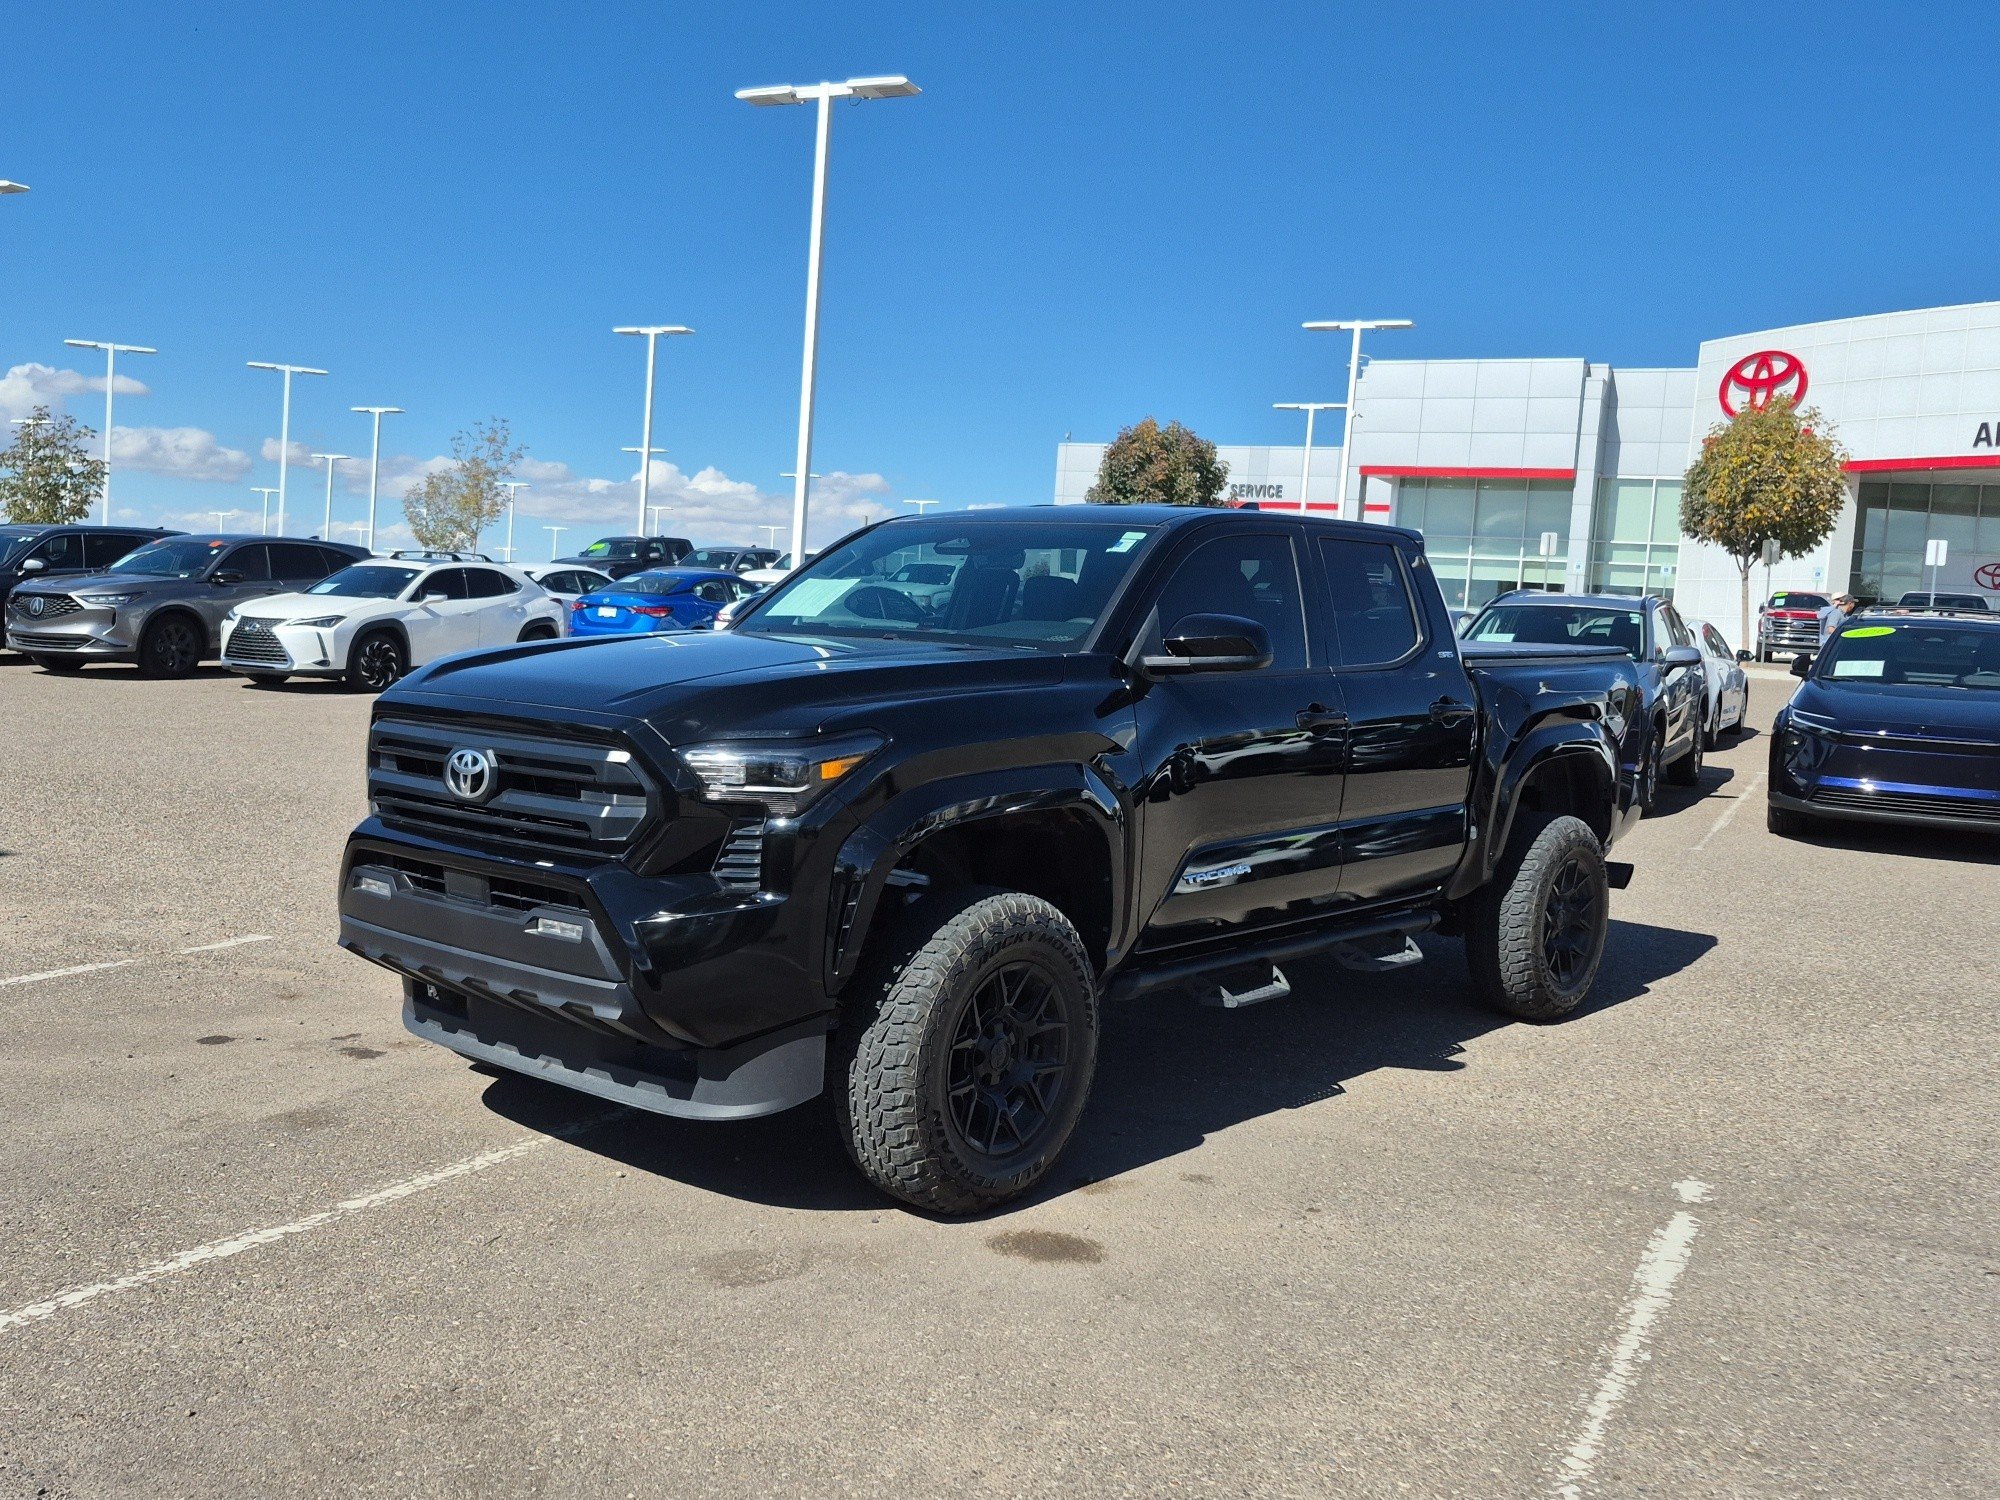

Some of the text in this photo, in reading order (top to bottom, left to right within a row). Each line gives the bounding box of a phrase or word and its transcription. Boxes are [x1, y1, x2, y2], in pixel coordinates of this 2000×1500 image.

[1230, 484, 1283, 499] SERVICE
[1182, 864, 1251, 884] TACOMA
[978, 931, 1094, 1030] ROCKY MOUNTAIN
